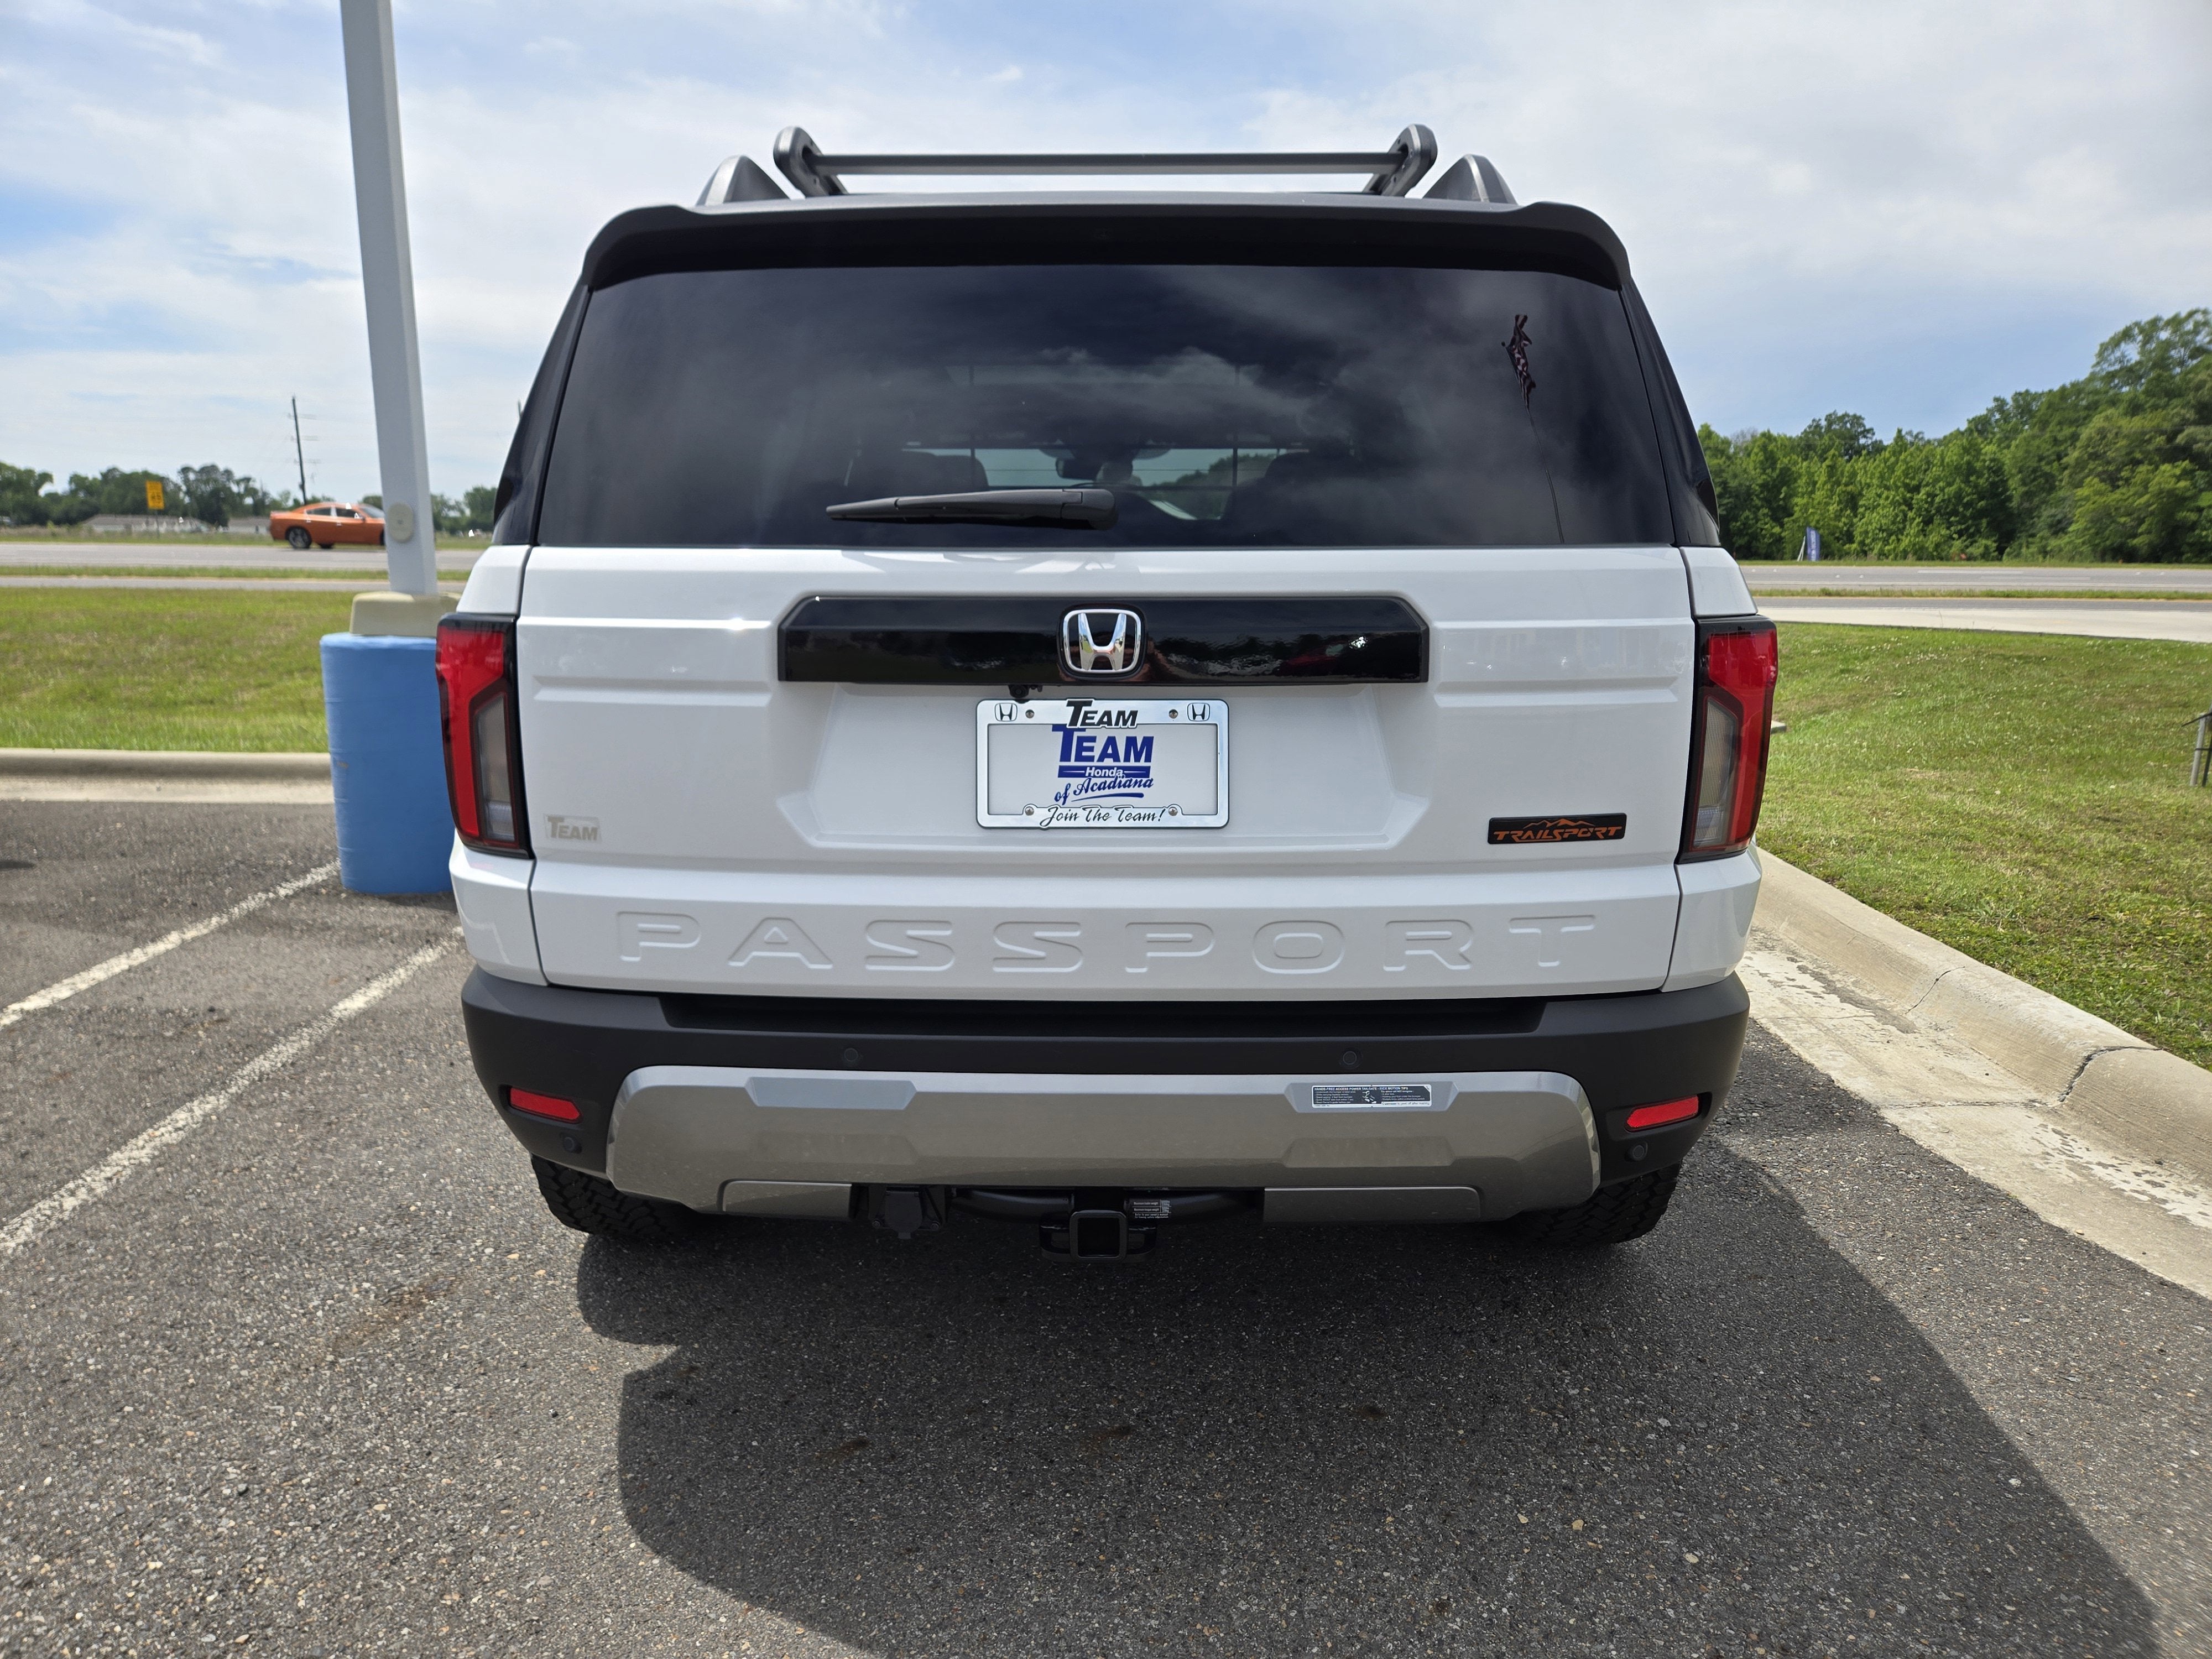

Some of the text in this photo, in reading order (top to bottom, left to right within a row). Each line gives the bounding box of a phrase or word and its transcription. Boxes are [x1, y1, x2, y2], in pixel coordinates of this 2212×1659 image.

[1066, 700, 1138, 727] TEAM
[1052, 724, 1154, 763] TEAM
[1085, 766, 1123, 777] Honda
[1054, 775, 1154, 806] of Acadiana
[547, 816, 598, 841] TEAM
[1039, 806, 1166, 827] Join The Team!
[1493, 826, 1622, 843] TRAILSPORT
[616, 911, 1597, 975] PASSPORT
